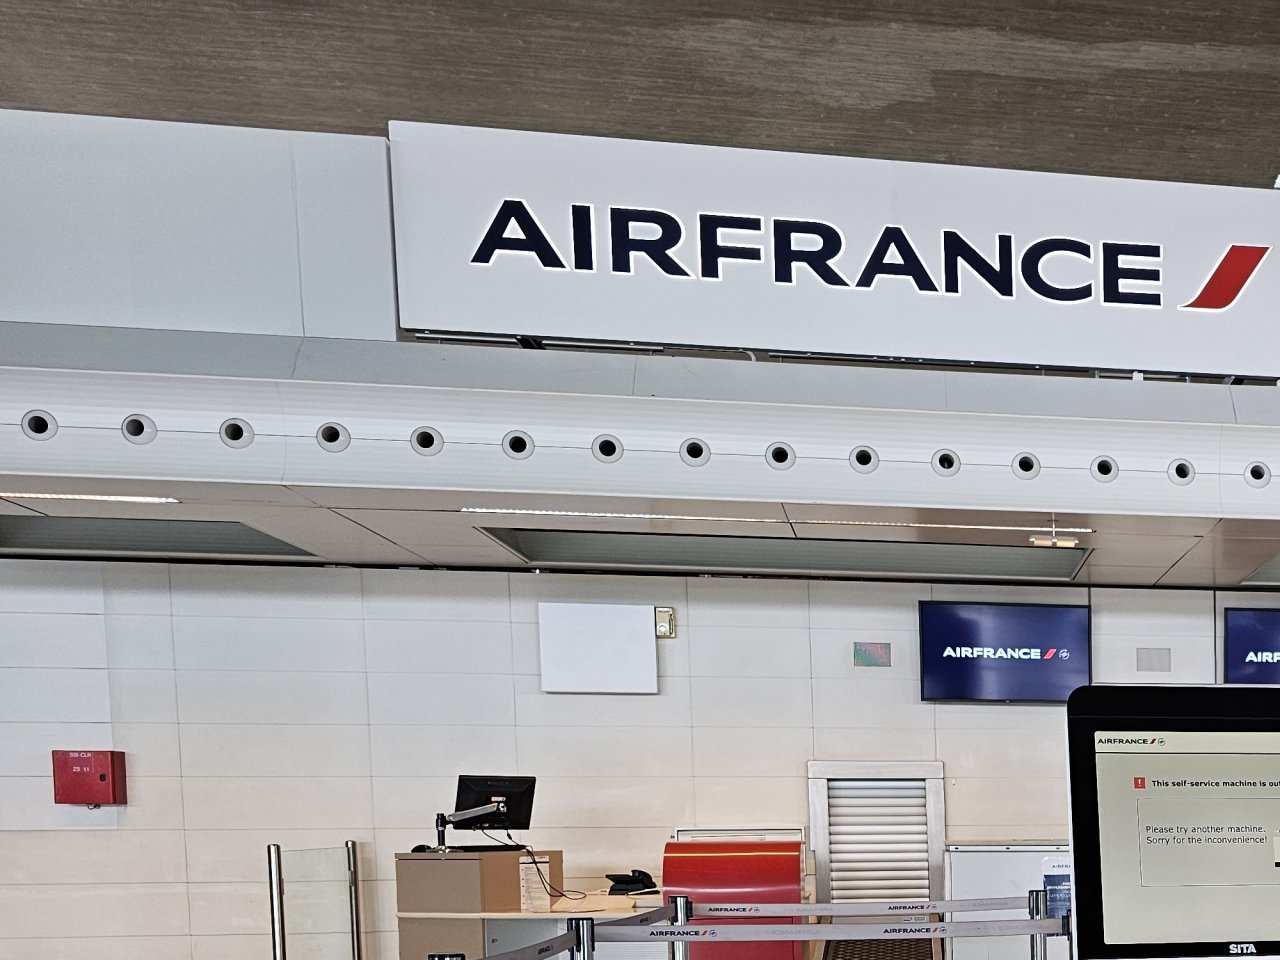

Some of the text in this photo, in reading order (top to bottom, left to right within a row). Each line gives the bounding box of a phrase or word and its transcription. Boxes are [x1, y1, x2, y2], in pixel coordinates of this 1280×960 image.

[471, 199, 1163, 306] AIRFRANCE
[942, 646, 1041, 660] AIRFRANCE
[1151, 780, 1168, 788] This
[1171, 780, 1220, 788] self-service
[1222, 780, 1257, 788] machine
[1259, 780, 1267, 788] is
[1146, 825, 1266, 836] Please try another machine.
[1146, 835, 1268, 846] Sorry for the inconvenience!
[1229, 944, 1257, 954] SITA
